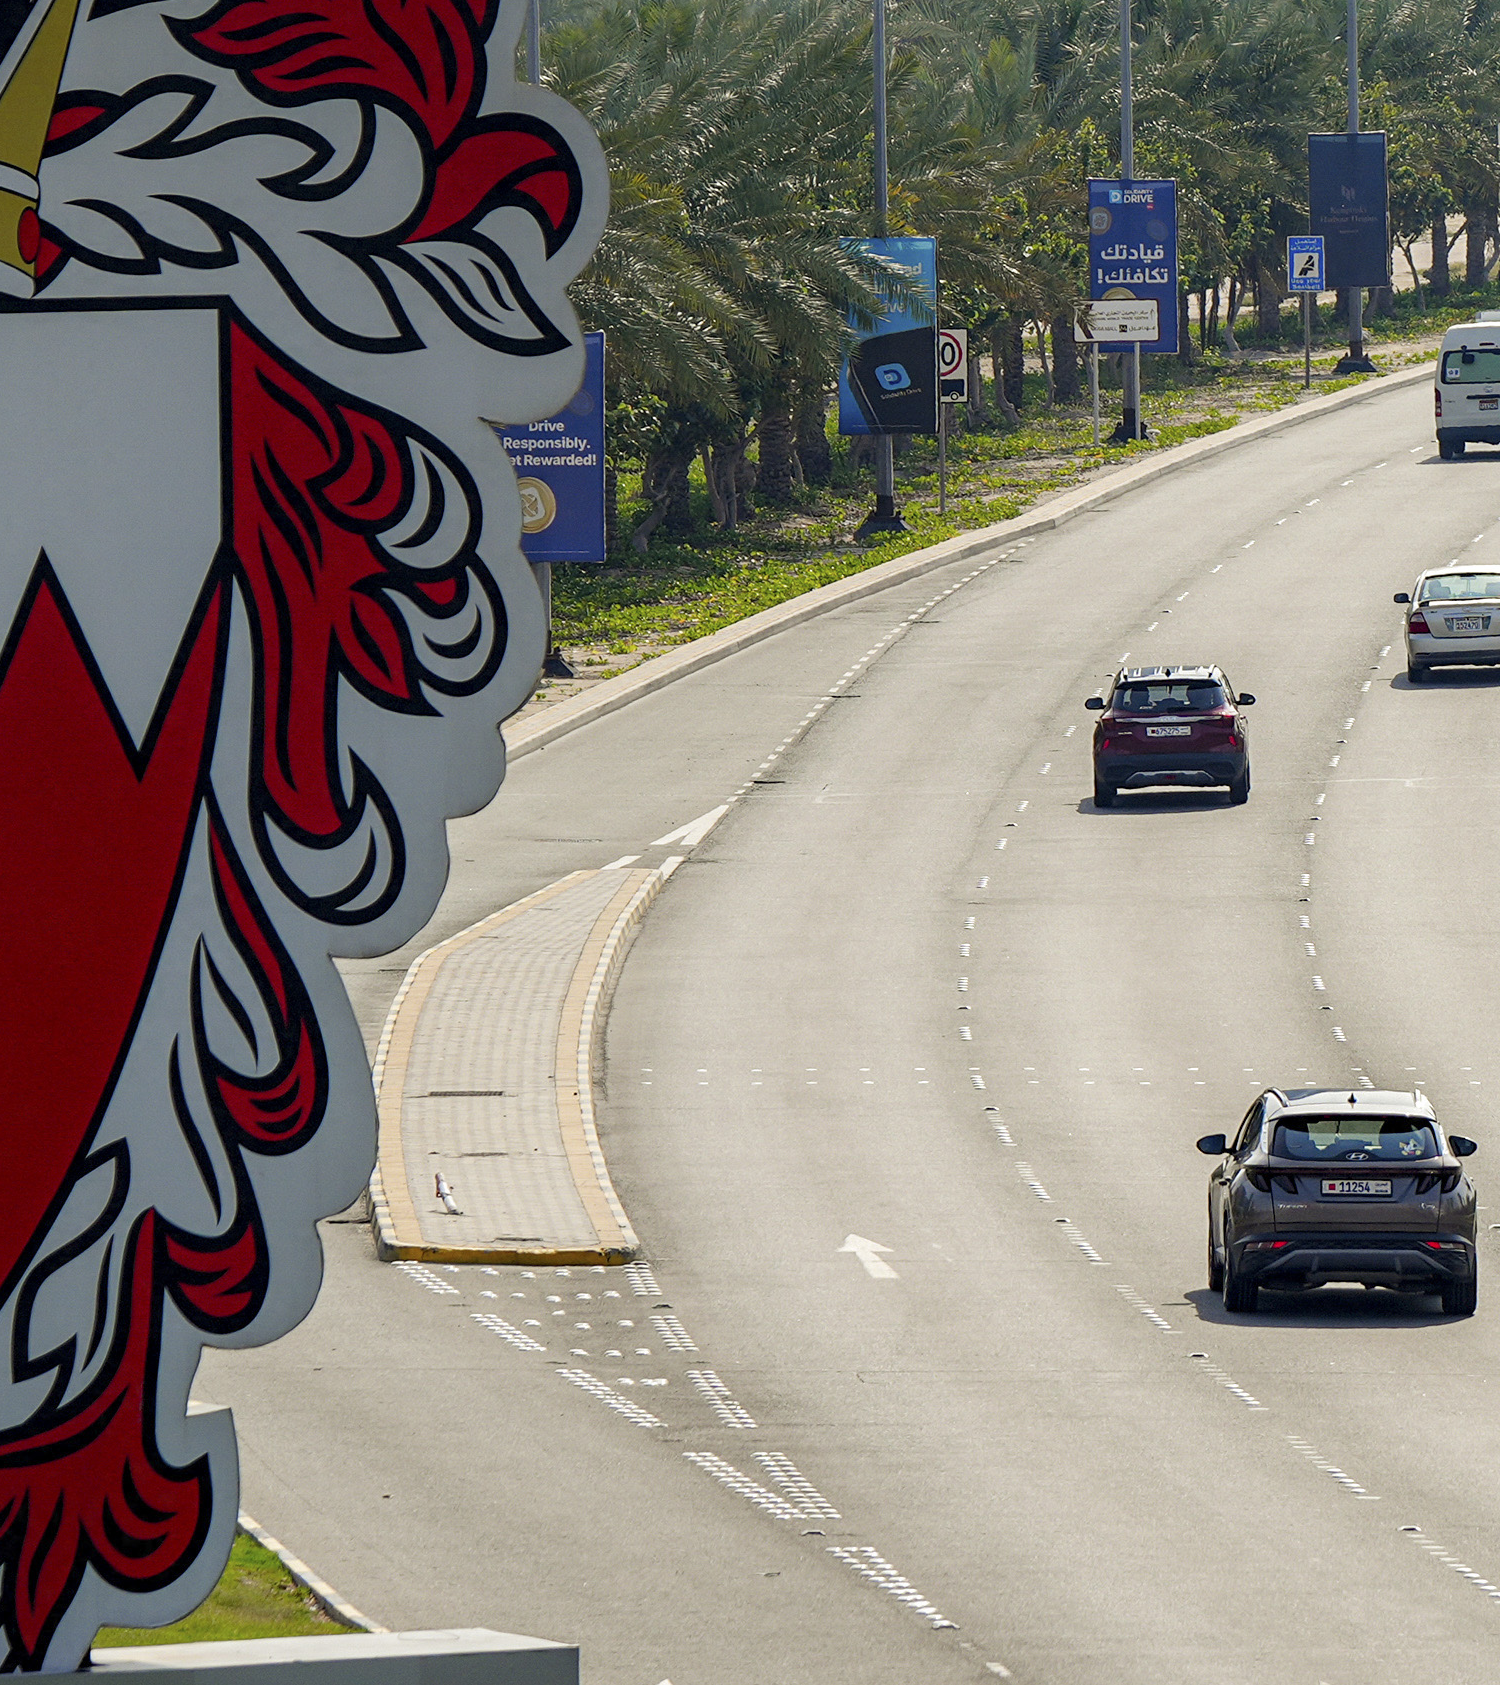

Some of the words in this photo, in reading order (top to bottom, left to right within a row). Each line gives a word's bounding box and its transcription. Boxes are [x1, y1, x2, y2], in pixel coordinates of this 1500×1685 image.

[1124, 195, 1153, 203] DRIVE
[1101, 244, 1164, 263] قيادتك
[1098, 267, 1168, 284] تكافئك!
[528, 422, 565, 432] Drive
[503, 436, 591, 451] Responsibly.
[509, 455, 523, 466] et
[524, 454, 597, 466] Rewarded!
[1339, 1181, 1371, 1193] 11254
